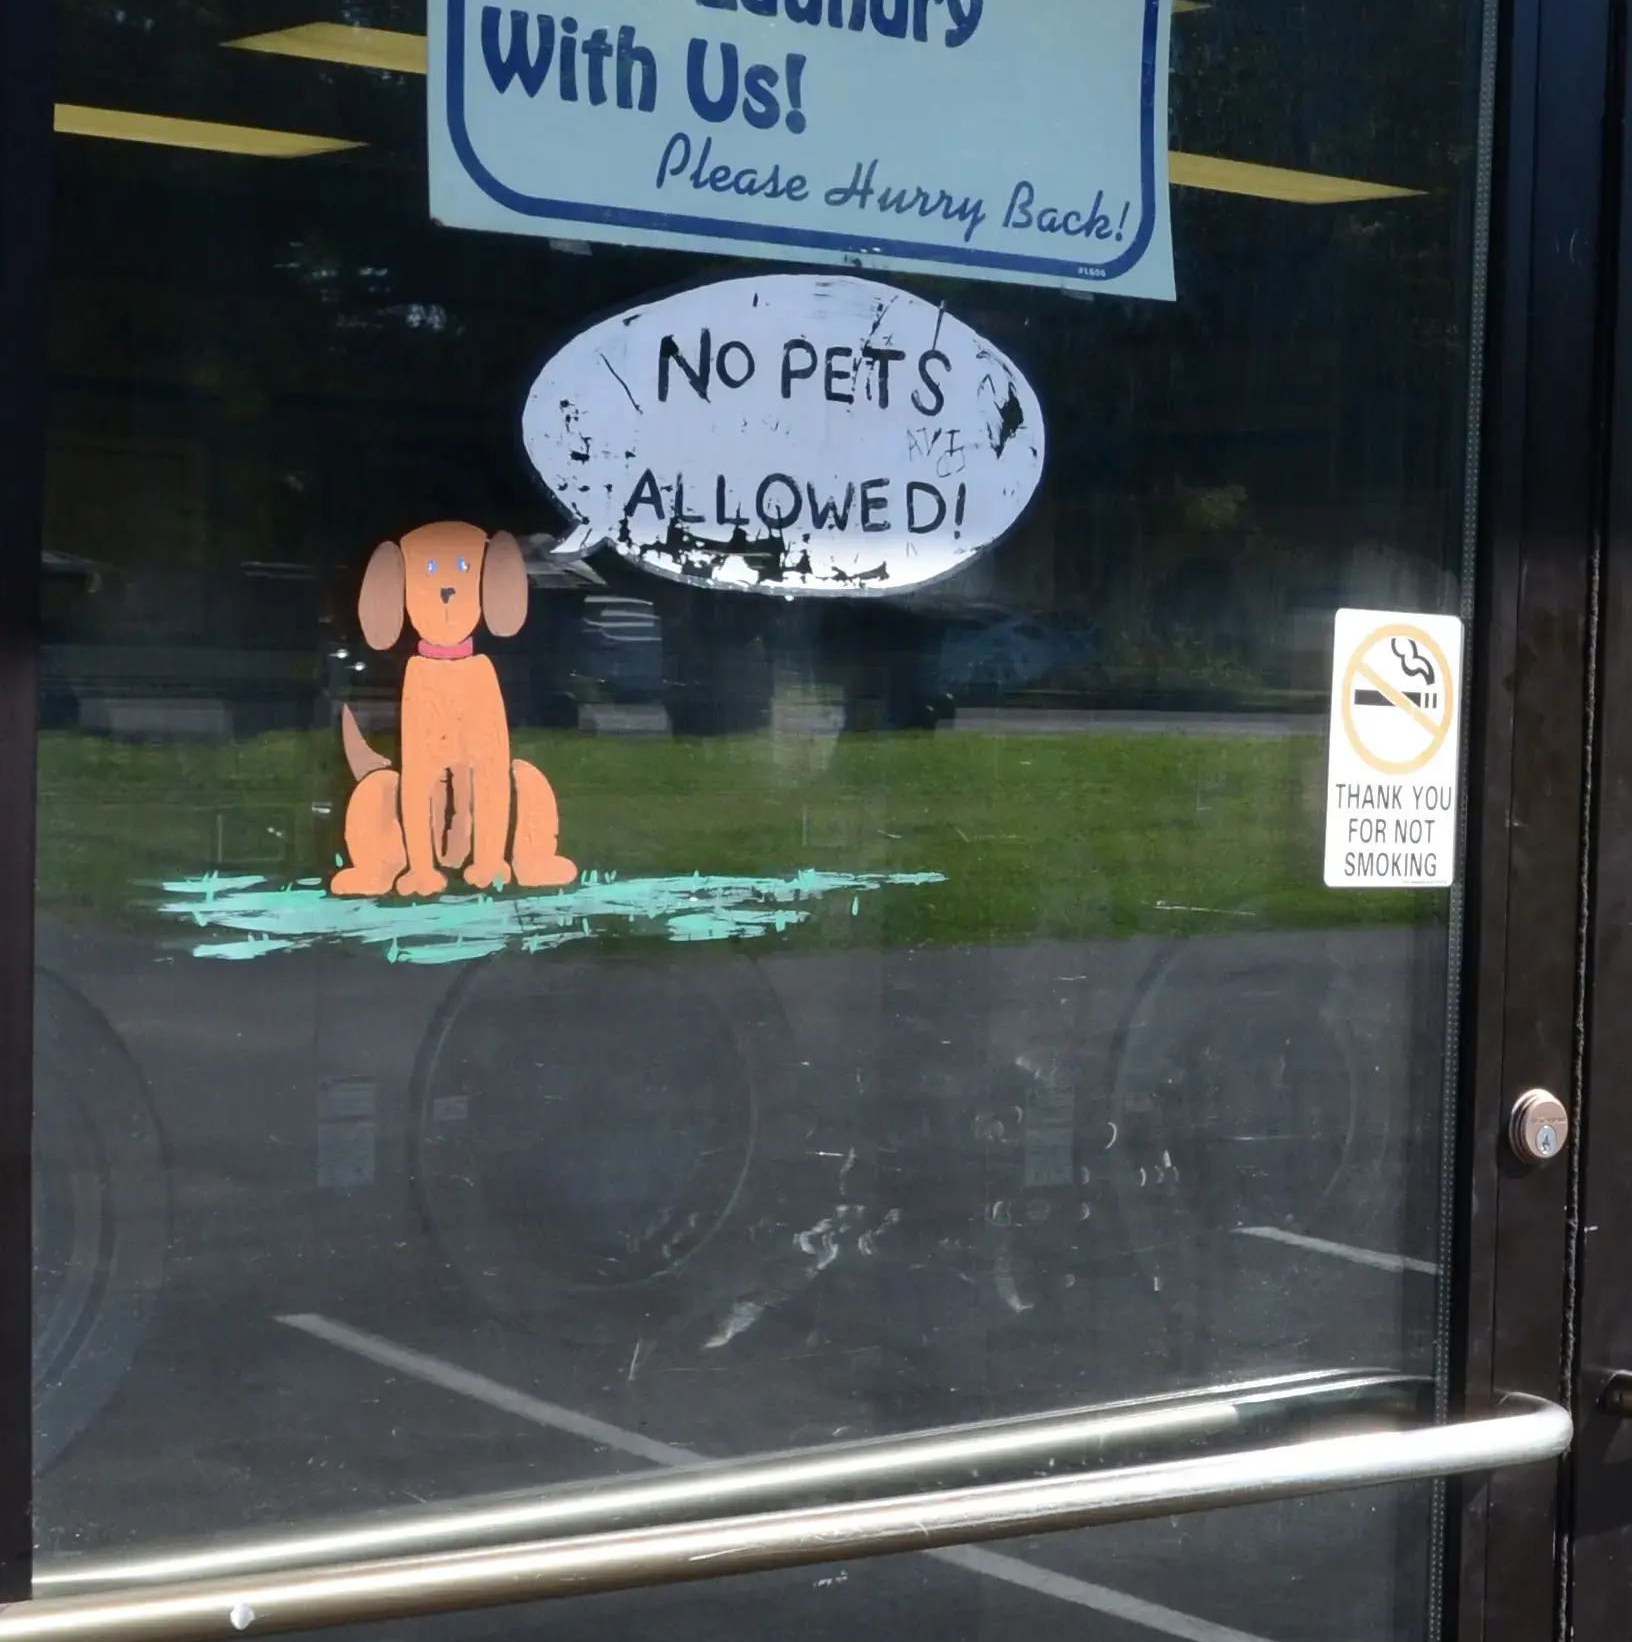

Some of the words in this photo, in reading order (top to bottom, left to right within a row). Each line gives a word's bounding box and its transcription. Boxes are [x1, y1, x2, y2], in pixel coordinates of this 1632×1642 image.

[480, 5, 657, 112] With
[687, 38, 807, 134] Us!
[656, 132, 809, 201] Please
[825, 160, 986, 242] Hurry
[1001, 181, 1130, 242] Back!
[658, 328, 754, 404] NO
[781, 338, 951, 417] PETS
[625, 468, 966, 539] ALLOWED!
[1335, 783, 1402, 810] THANK
[1411, 784, 1452, 811] YOU
[1348, 818, 1388, 844] FOR
[1395, 818, 1436, 845] NOT
[1344, 851, 1437, 878] SMOKING
